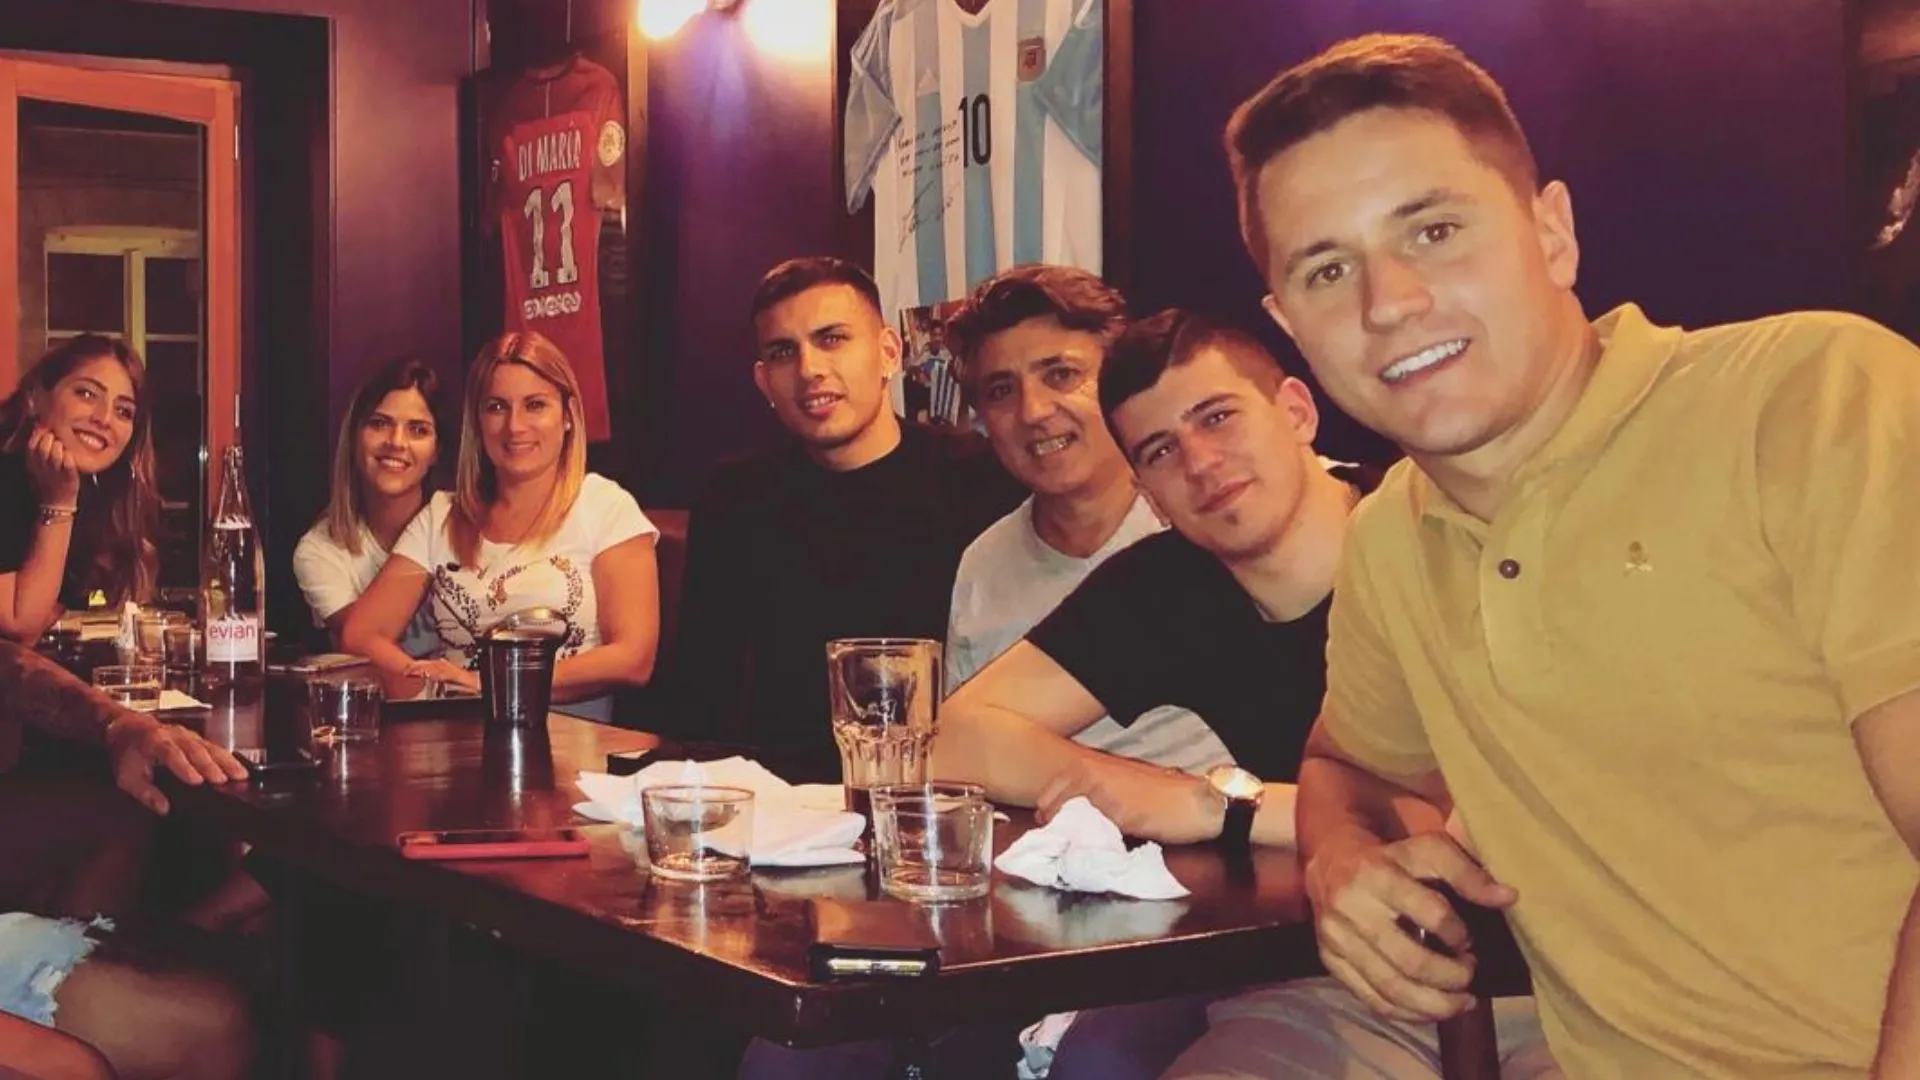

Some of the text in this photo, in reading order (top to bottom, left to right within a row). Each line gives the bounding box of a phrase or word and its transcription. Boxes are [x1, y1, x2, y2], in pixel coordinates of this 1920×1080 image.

[958, 94, 992, 168] 10
[518, 141, 533, 182] DI
[523, 180, 579, 289] 11
[209, 622, 255, 639] evian
